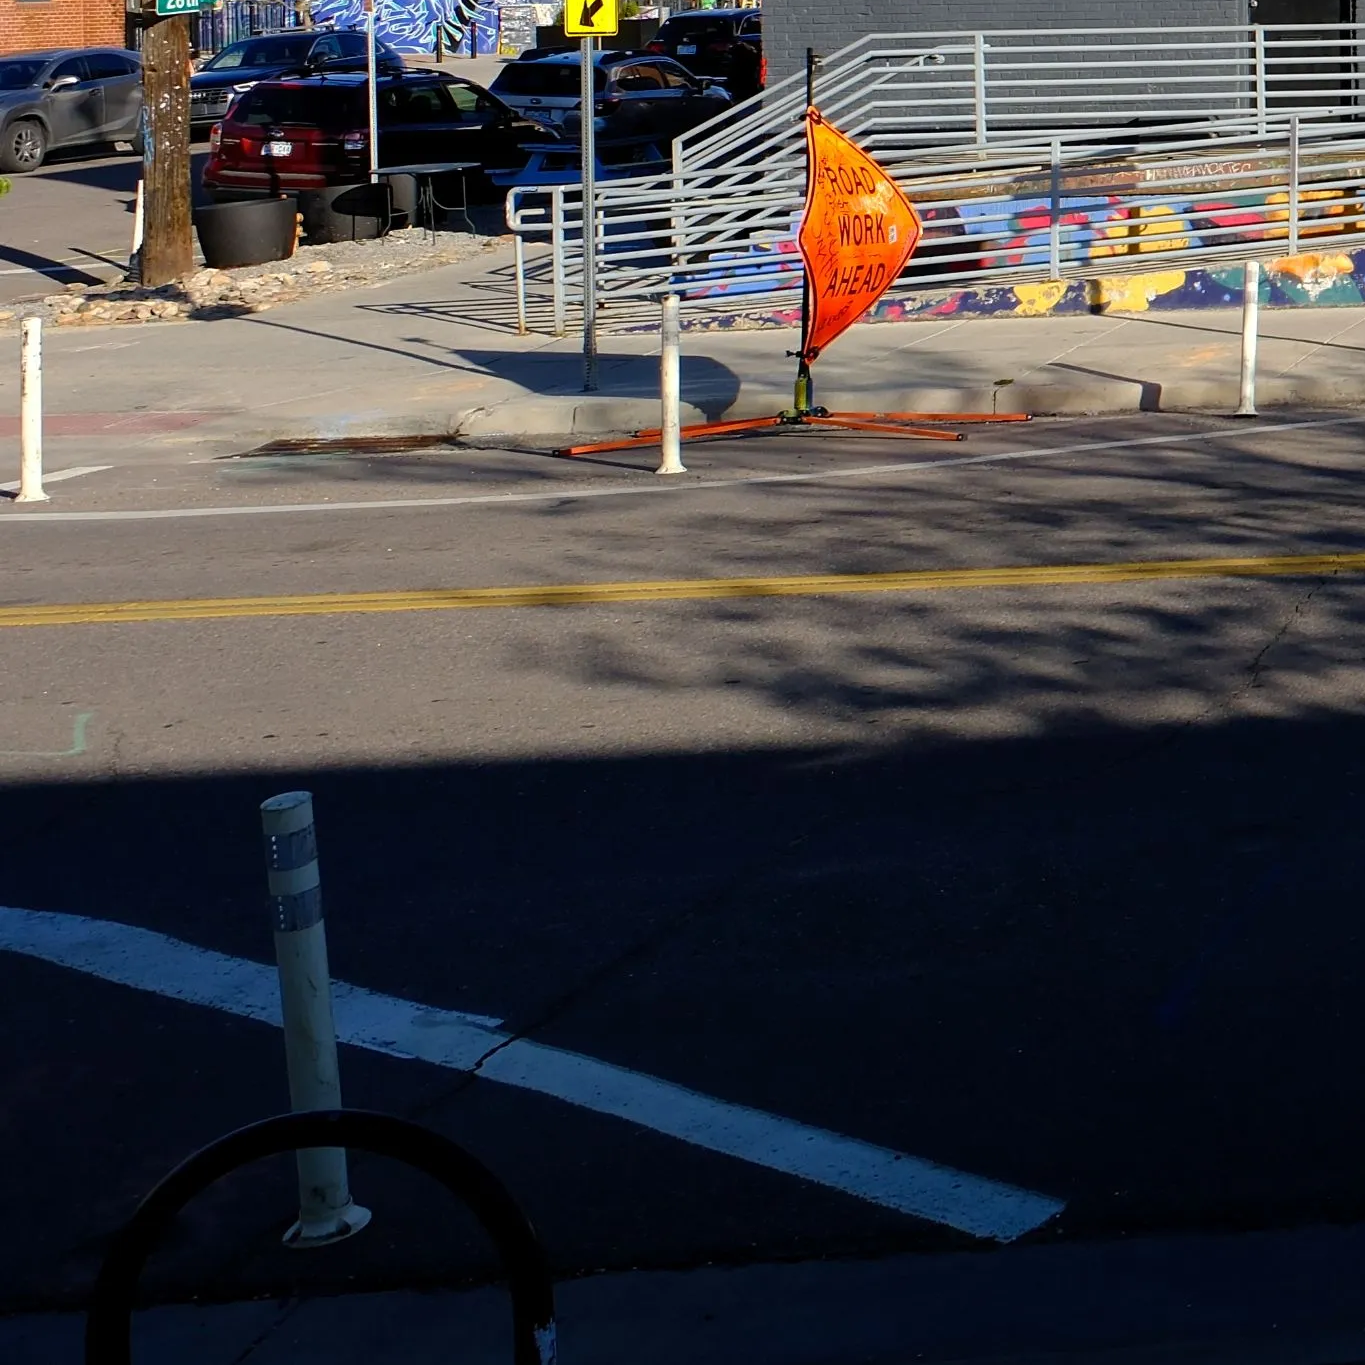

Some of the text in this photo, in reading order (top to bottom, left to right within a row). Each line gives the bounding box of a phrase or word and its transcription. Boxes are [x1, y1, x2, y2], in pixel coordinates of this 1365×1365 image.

[824, 166, 876, 196] ROAD
[837, 213, 886, 248] WORK
[822, 261, 887, 299] AHEAD
